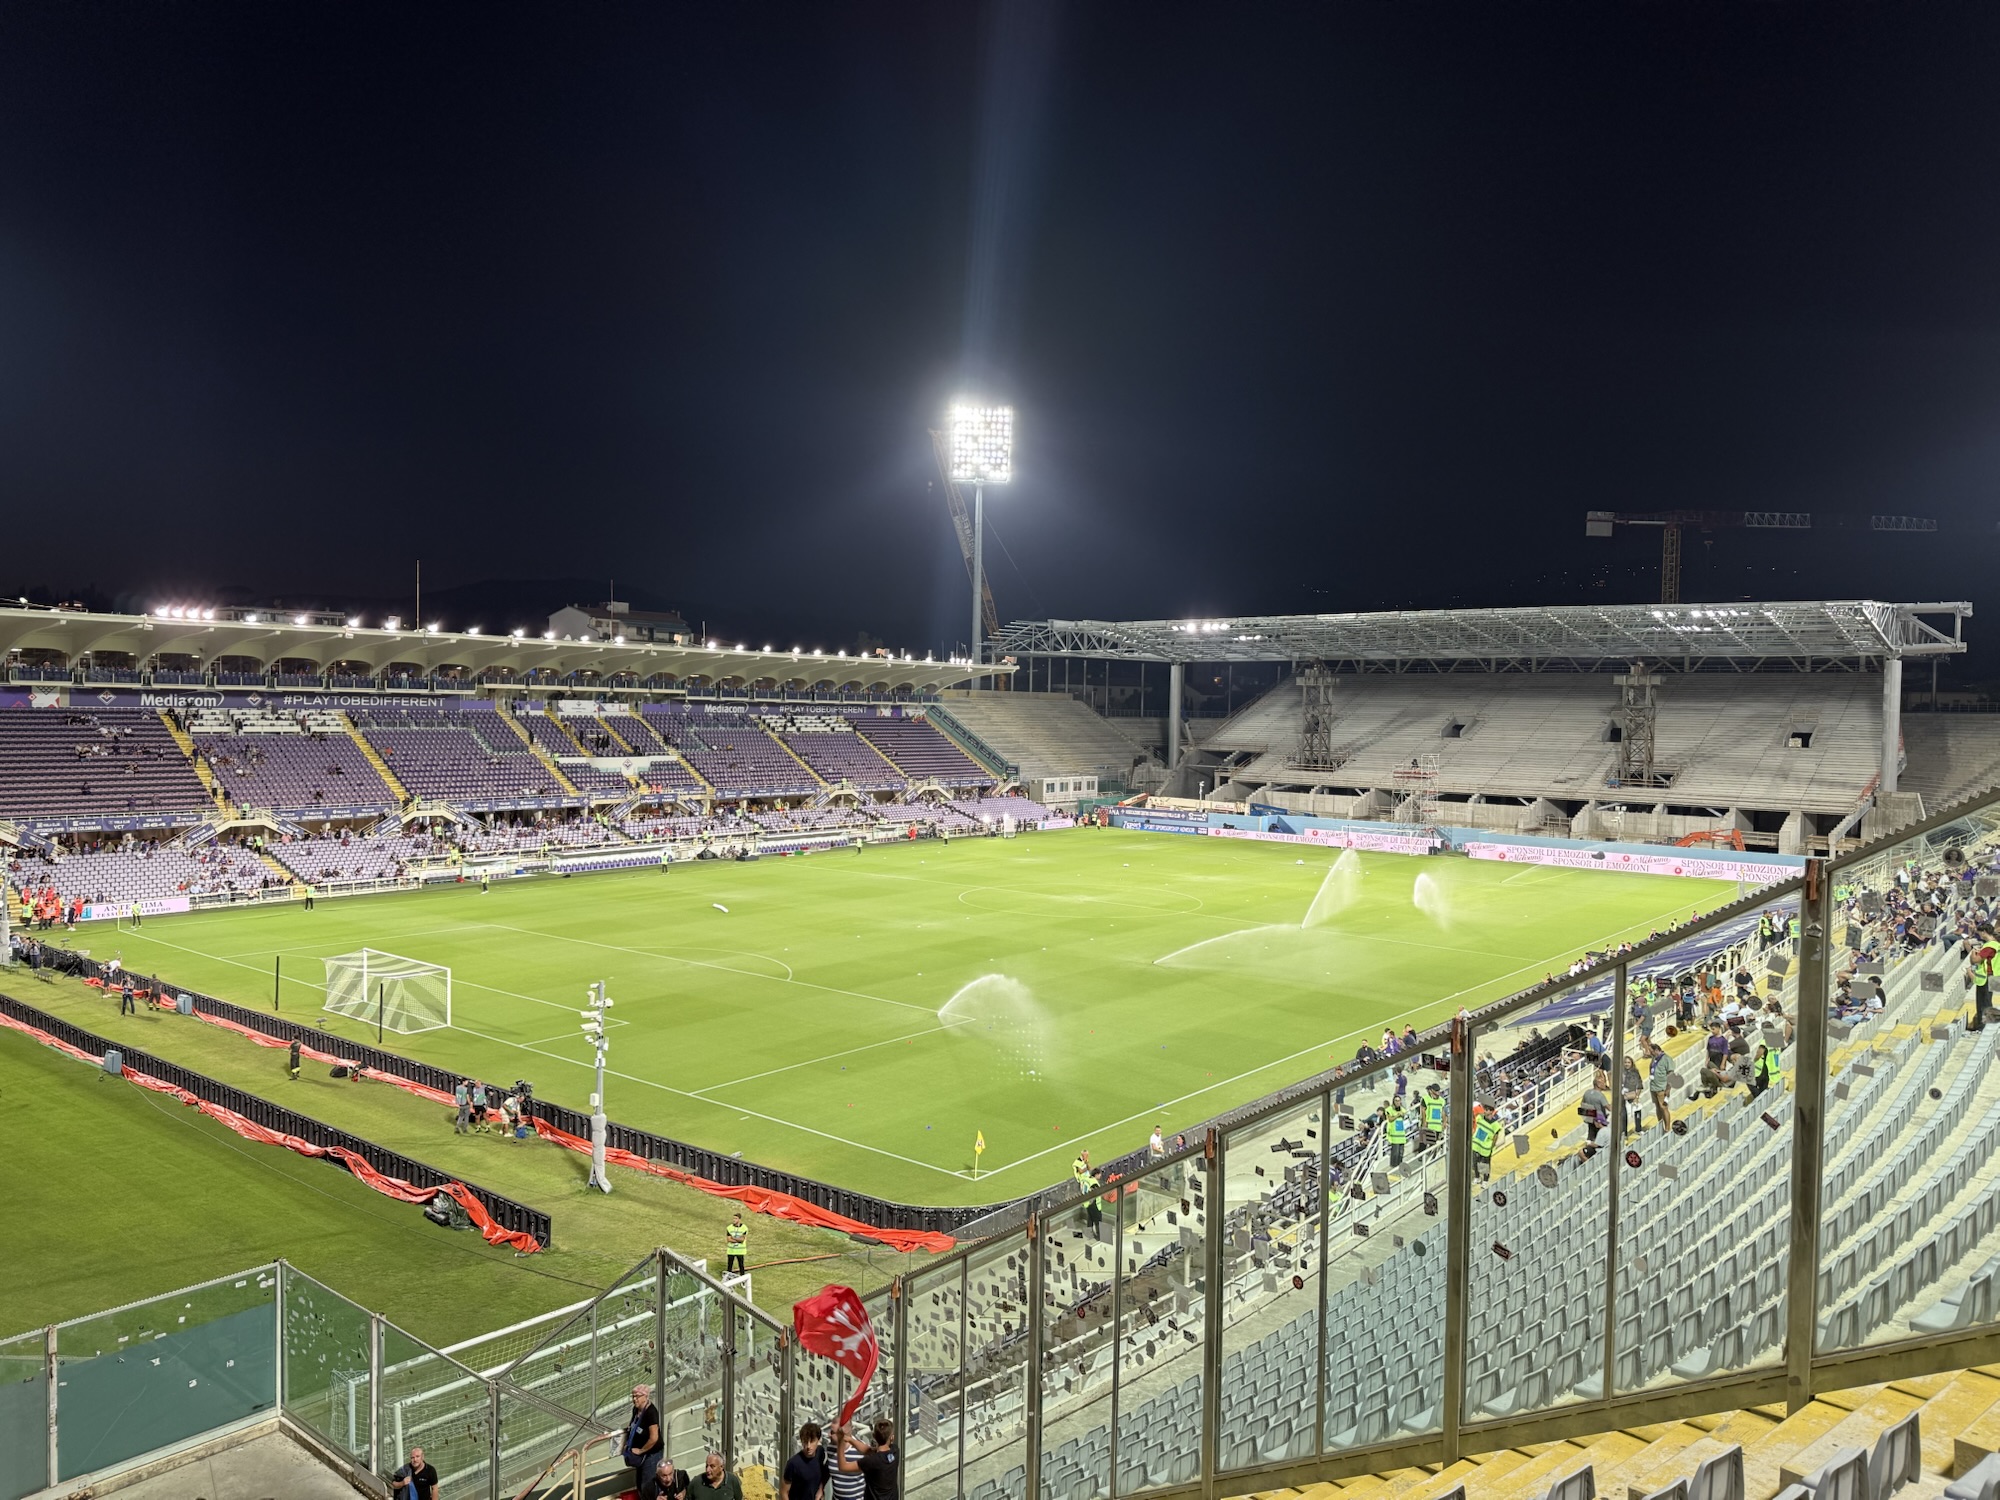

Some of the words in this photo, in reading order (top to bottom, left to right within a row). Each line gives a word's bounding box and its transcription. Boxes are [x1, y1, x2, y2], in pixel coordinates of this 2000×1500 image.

[140, 693, 219, 707] Mediacom
[283, 695, 446, 708] #PLAYTOBEDIFFERENT
[704, 704, 746, 713] Mediacom
[779, 704, 867, 714] #PLAYTOBEDIFFERENT
[1255, 832, 1285, 842] SPONSOR
[1286, 834, 1293, 842] DI
[1295, 835, 1328, 845] EMOZIONI
[1356, 833, 1388, 844] SPONSOR
[1390, 836, 1398, 844] DI
[1506, 846, 1546, 856] SPONSOR
[1546, 848, 1556, 857] DI
[1552, 858, 1592, 868] SPONSOR
[1594, 861, 1604, 869] DI
[1606, 862, 1650, 873] EMOZIONI
[1681, 859, 1725, 871] SPONSOR
[1726, 862, 1737, 872] DI
[1740, 863, 1788, 875] EMOZIONI
[104, 901, 163, 912] ANTERIMA
